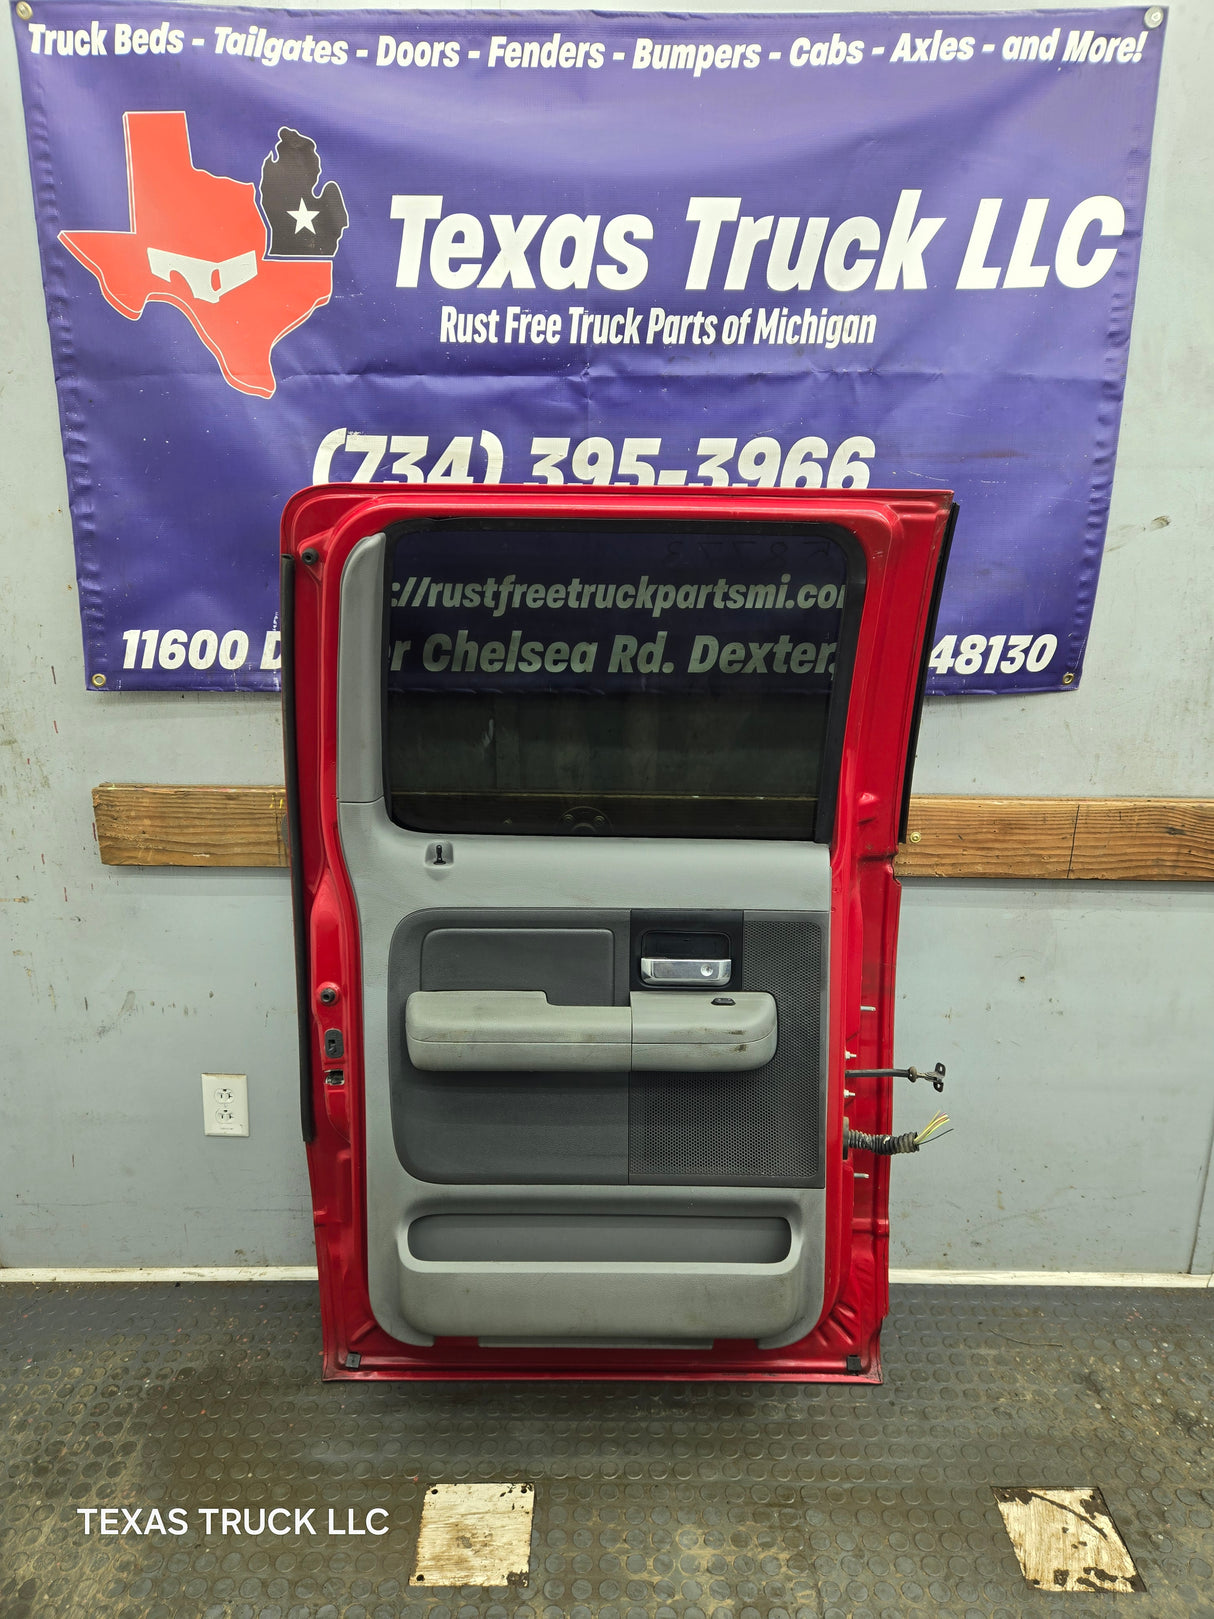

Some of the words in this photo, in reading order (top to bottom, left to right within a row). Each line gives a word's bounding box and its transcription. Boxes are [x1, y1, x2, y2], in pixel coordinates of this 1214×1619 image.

[29, 21, 107, 55] Truck
[115, 22, 184, 54] Beds
[215, 26, 348, 66] Tailgates
[376, 36, 460, 67] Doors
[488, 33, 605, 68] Fenders
[632, 39, 761, 77] Bumpers
[790, 34, 864, 66] Cabs
[890, 30, 975, 62] Axles
[1003, 28, 1060, 60] and
[1062, 31, 1148, 62] More!
[390, 195, 653, 290] Texas
[685, 190, 946, 291] Truck
[956, 196, 1124, 289] LLC
[440, 306, 499, 343] Rust
[505, 307, 561, 344] Free
[569, 307, 642, 344] Truck
[646, 308, 717, 344] Parts
[722, 308, 752, 344] of
[753, 307, 877, 349] Michigan
[313, 428, 503, 482] (734)
[520, 436, 875, 489] 395-3966
[123, 629, 249, 669] 11600
[424, 630, 598, 673] Chelsea
[608, 631, 674, 673] Rd.
[929, 634, 1057, 674] 48130
